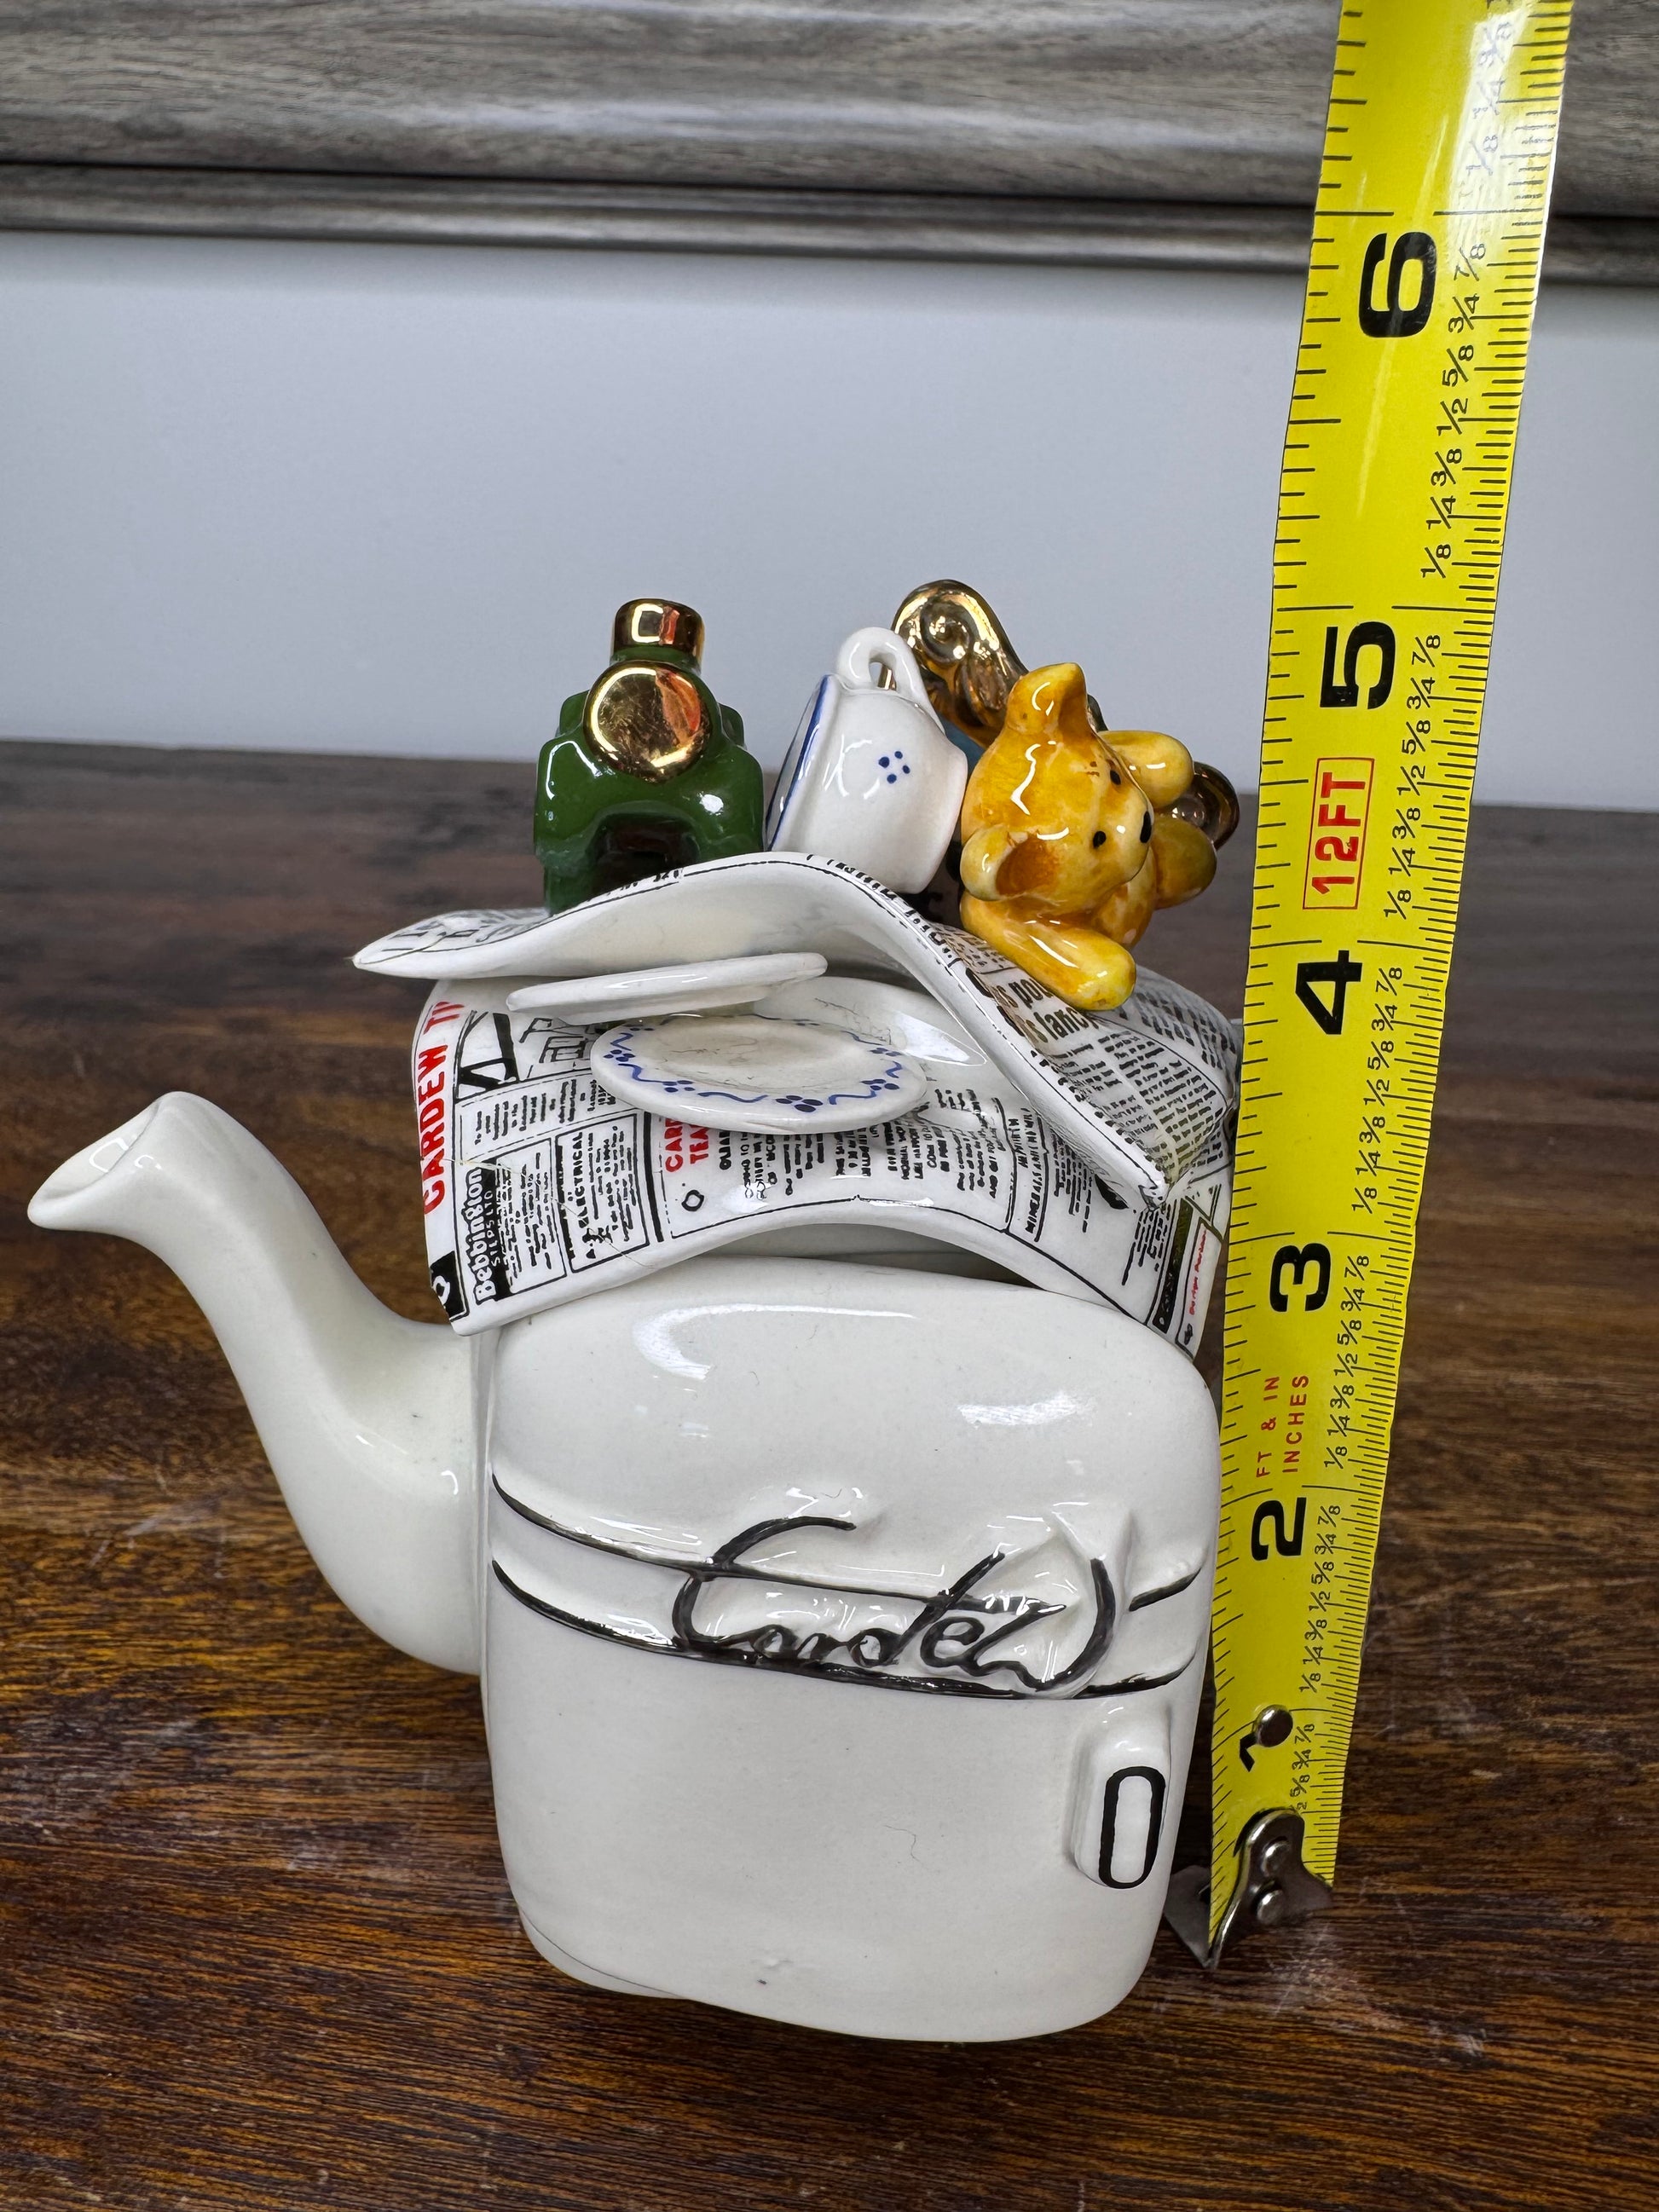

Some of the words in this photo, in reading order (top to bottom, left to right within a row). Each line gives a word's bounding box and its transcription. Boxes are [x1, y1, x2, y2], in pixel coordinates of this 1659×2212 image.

[1454, 243, 1486, 281] 7/8
[1358, 231, 1437, 338] 6
[1448, 292, 1480, 333] 3/4
[1442, 344, 1474, 387] 5/8
[1436, 398, 1468, 436] 1/2
[1431, 448, 1462, 487] 3/8
[1425, 495, 1456, 530] 1/4
[1420, 544, 1451, 579] 1/8
[1320, 621, 1396, 710] 5
[1411, 634, 1441, 667] 7/8
[1406, 676, 1436, 710] 3/4
[1402, 719, 1431, 754] 5/8
[1396, 765, 1426, 796] 1/2
[1311, 771, 1367, 894] 12FT
[1391, 807, 1421, 840] 3/8
[1388, 846, 1416, 877] 1/4
[1383, 889, 1412, 920] 1/8
[1295, 950, 1363, 1035] 4
[1375, 967, 1402, 996] 7/8
[1371, 1003, 1398, 1031] 3/4
[1367, 1040, 1394, 1070] 5/8
[1363, 1078, 1390, 1106] 1/2
[416, 1044, 449, 1215] CARDEW
[1359, 1116, 1386, 1143] 3/8
[1355, 1150, 1381, 1176] 1/4
[1351, 1187, 1378, 1214] 1/8
[463, 1168, 496, 1302] Bebbington
[1269, 1243, 1332, 1312] 3
[1344, 1256, 1369, 1280] 7/8
[1340, 1286, 1365, 1312] 3/4
[1337, 1320, 1361, 1346] 5/8
[1334, 1353, 1358, 1377] 1/2
[1263, 1377, 1280, 1401] IN
[1330, 1384, 1355, 1409] 3/8
[1261, 1417, 1276, 1431] &
[1282, 1375, 1309, 1473] INCHES
[1327, 1414, 1350, 1436] 1/4
[1256, 1451, 1272, 1478] FT
[1324, 1446, 1348, 1469] 1/8
[1251, 1497, 1307, 1561] 2
[1317, 1505, 1340, 1528] 7/8
[1314, 1533, 1337, 1555] 3/4
[1311, 1561, 1334, 1585] 5/8
[1309, 1591, 1331, 1612] 1/2
[1304, 1619, 1327, 1640] 3/8
[1299, 1673, 1321, 1693] 1/8
